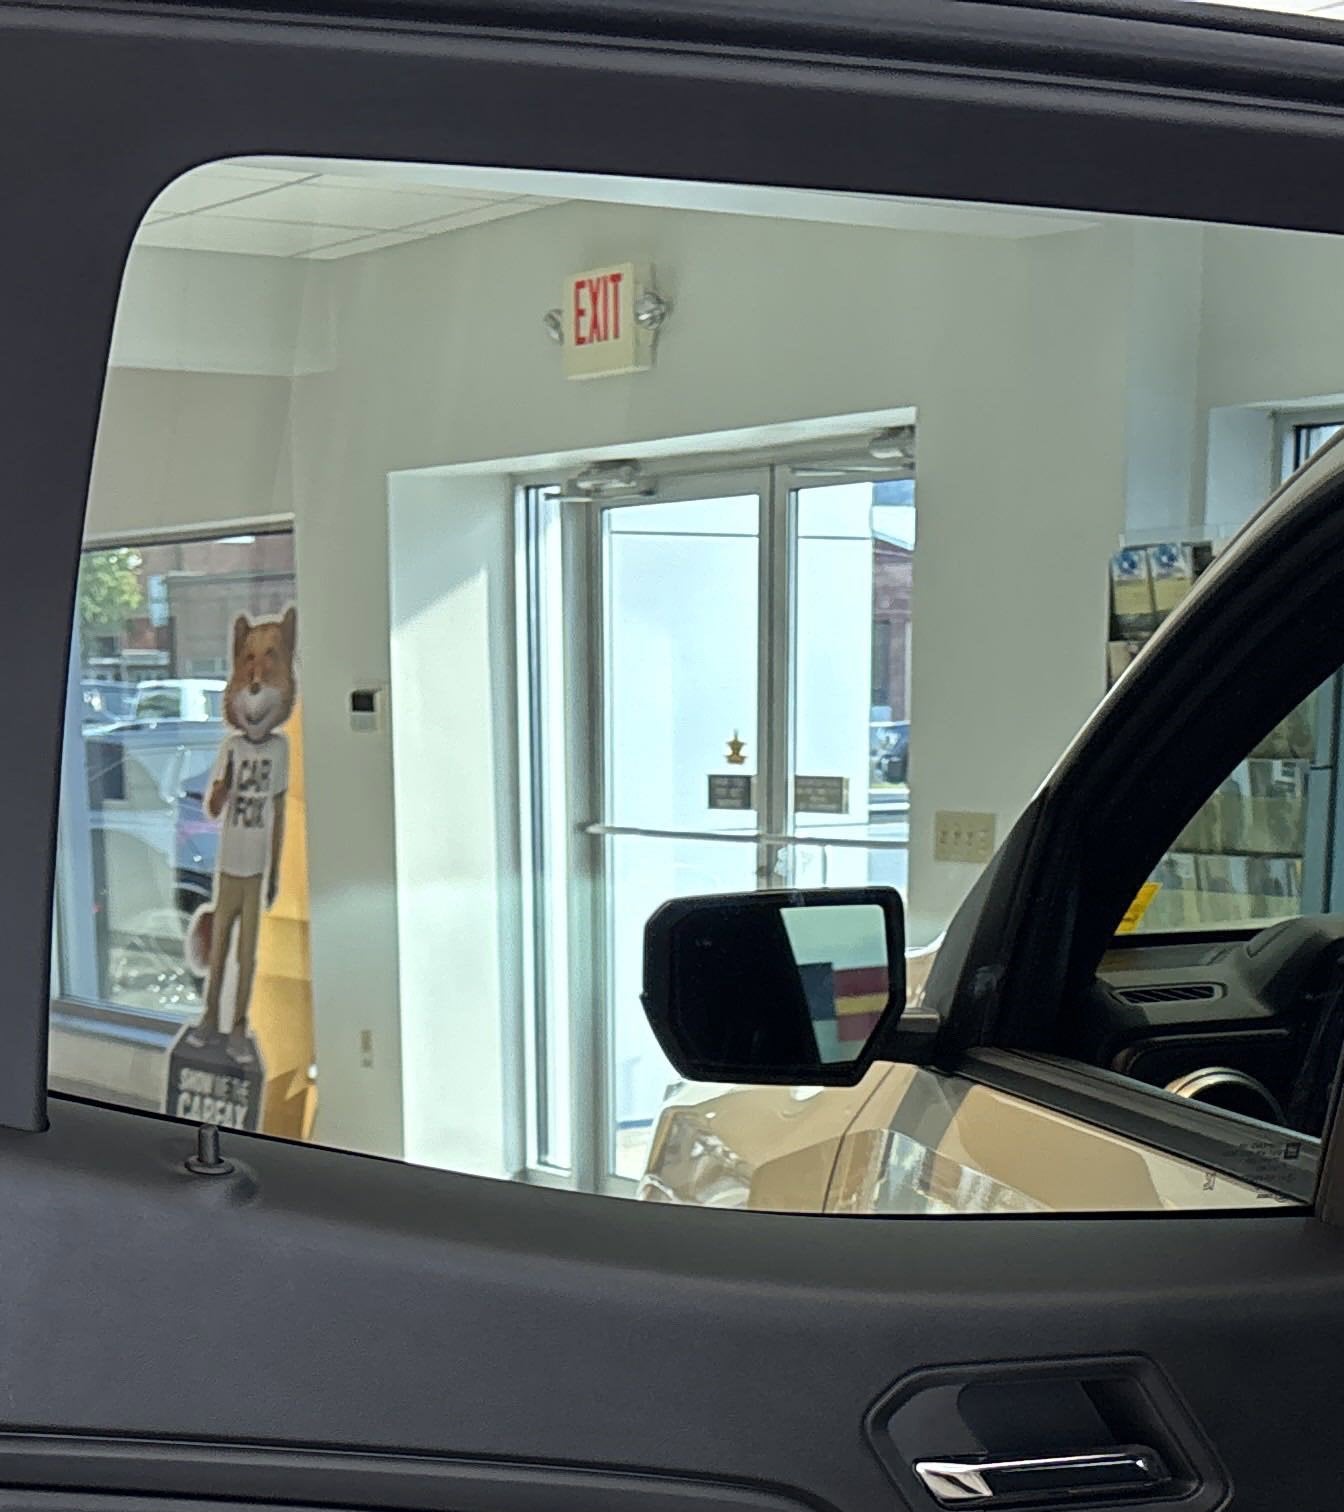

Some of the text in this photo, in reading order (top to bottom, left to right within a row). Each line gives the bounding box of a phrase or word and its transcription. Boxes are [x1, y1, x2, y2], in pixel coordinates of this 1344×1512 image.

[575, 273, 622, 346] EXIT
[237, 760, 273, 792] CAR
[232, 795, 267, 828] FOX
